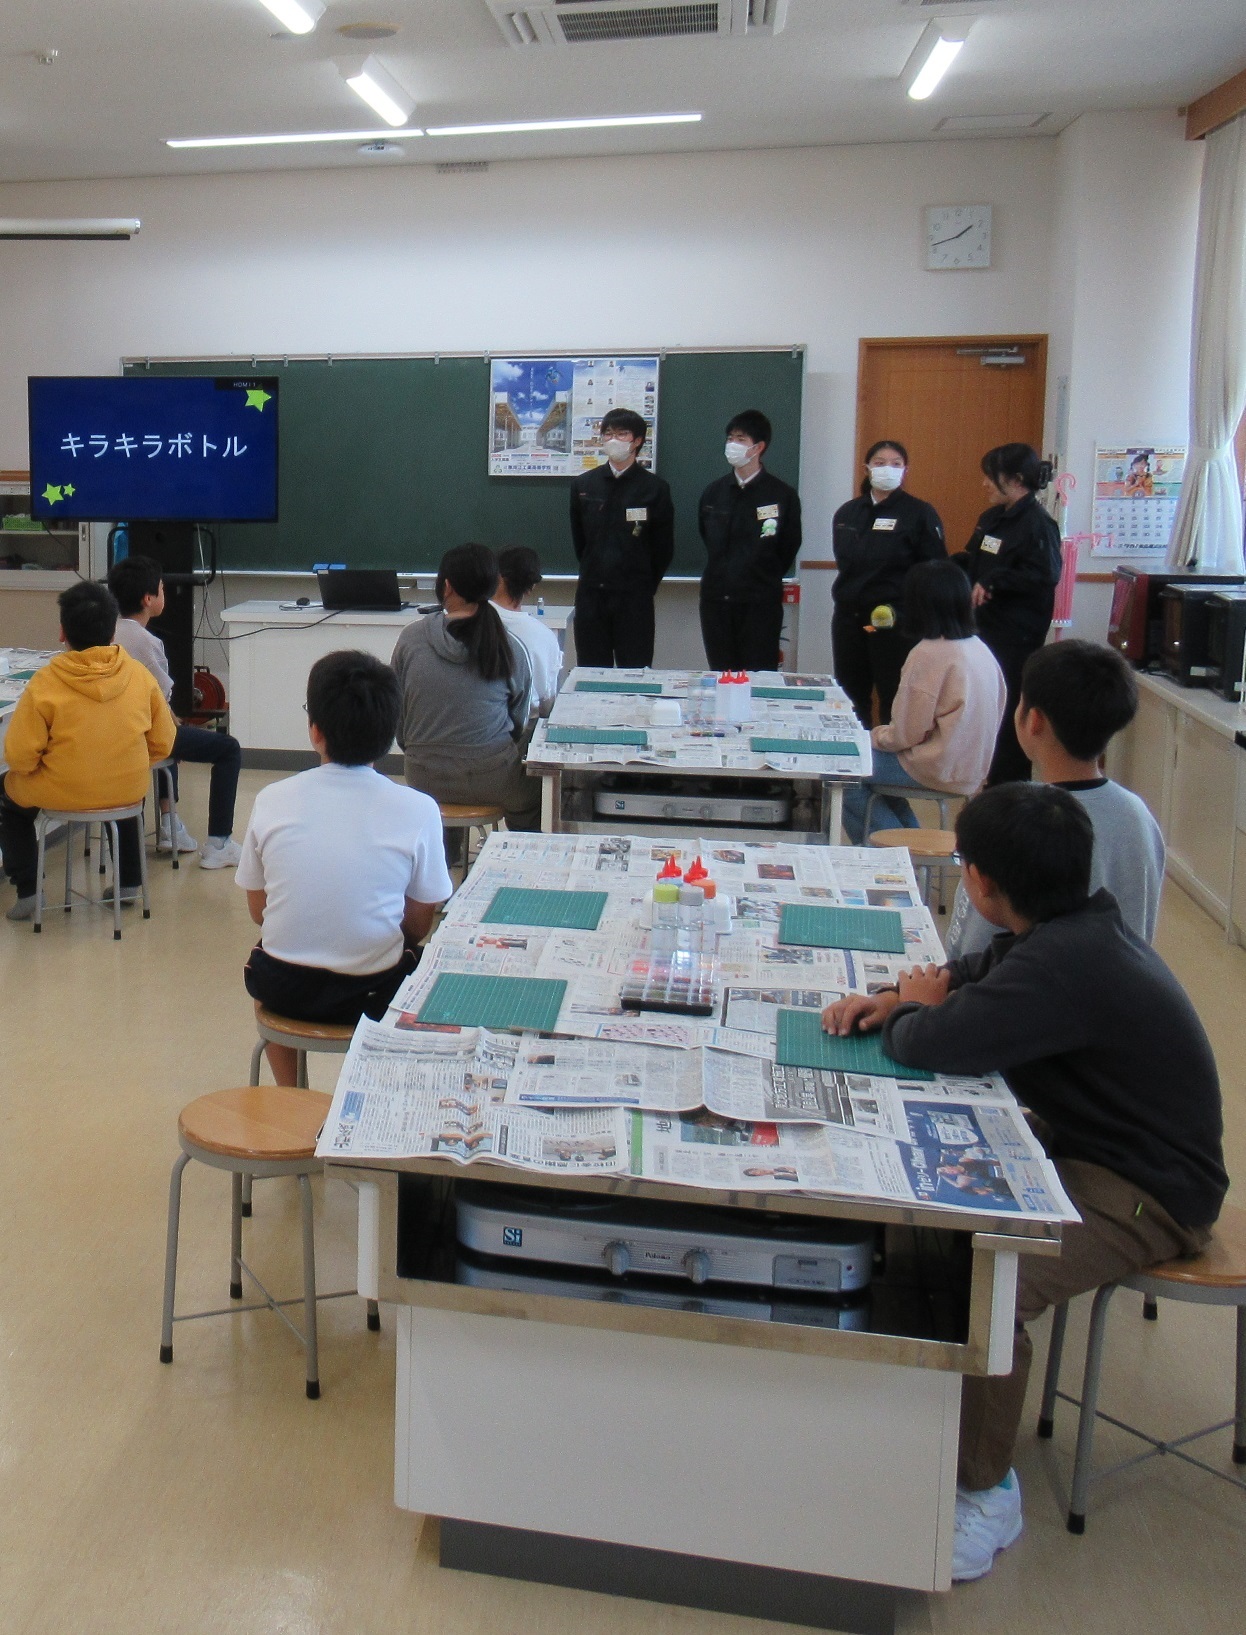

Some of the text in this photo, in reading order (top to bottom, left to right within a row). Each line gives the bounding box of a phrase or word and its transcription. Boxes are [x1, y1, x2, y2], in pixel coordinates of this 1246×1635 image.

[60, 432, 248, 458] キラキラボトル
[615, 800, 624, 809] Si
[504, 1227, 520, 1243] Si
